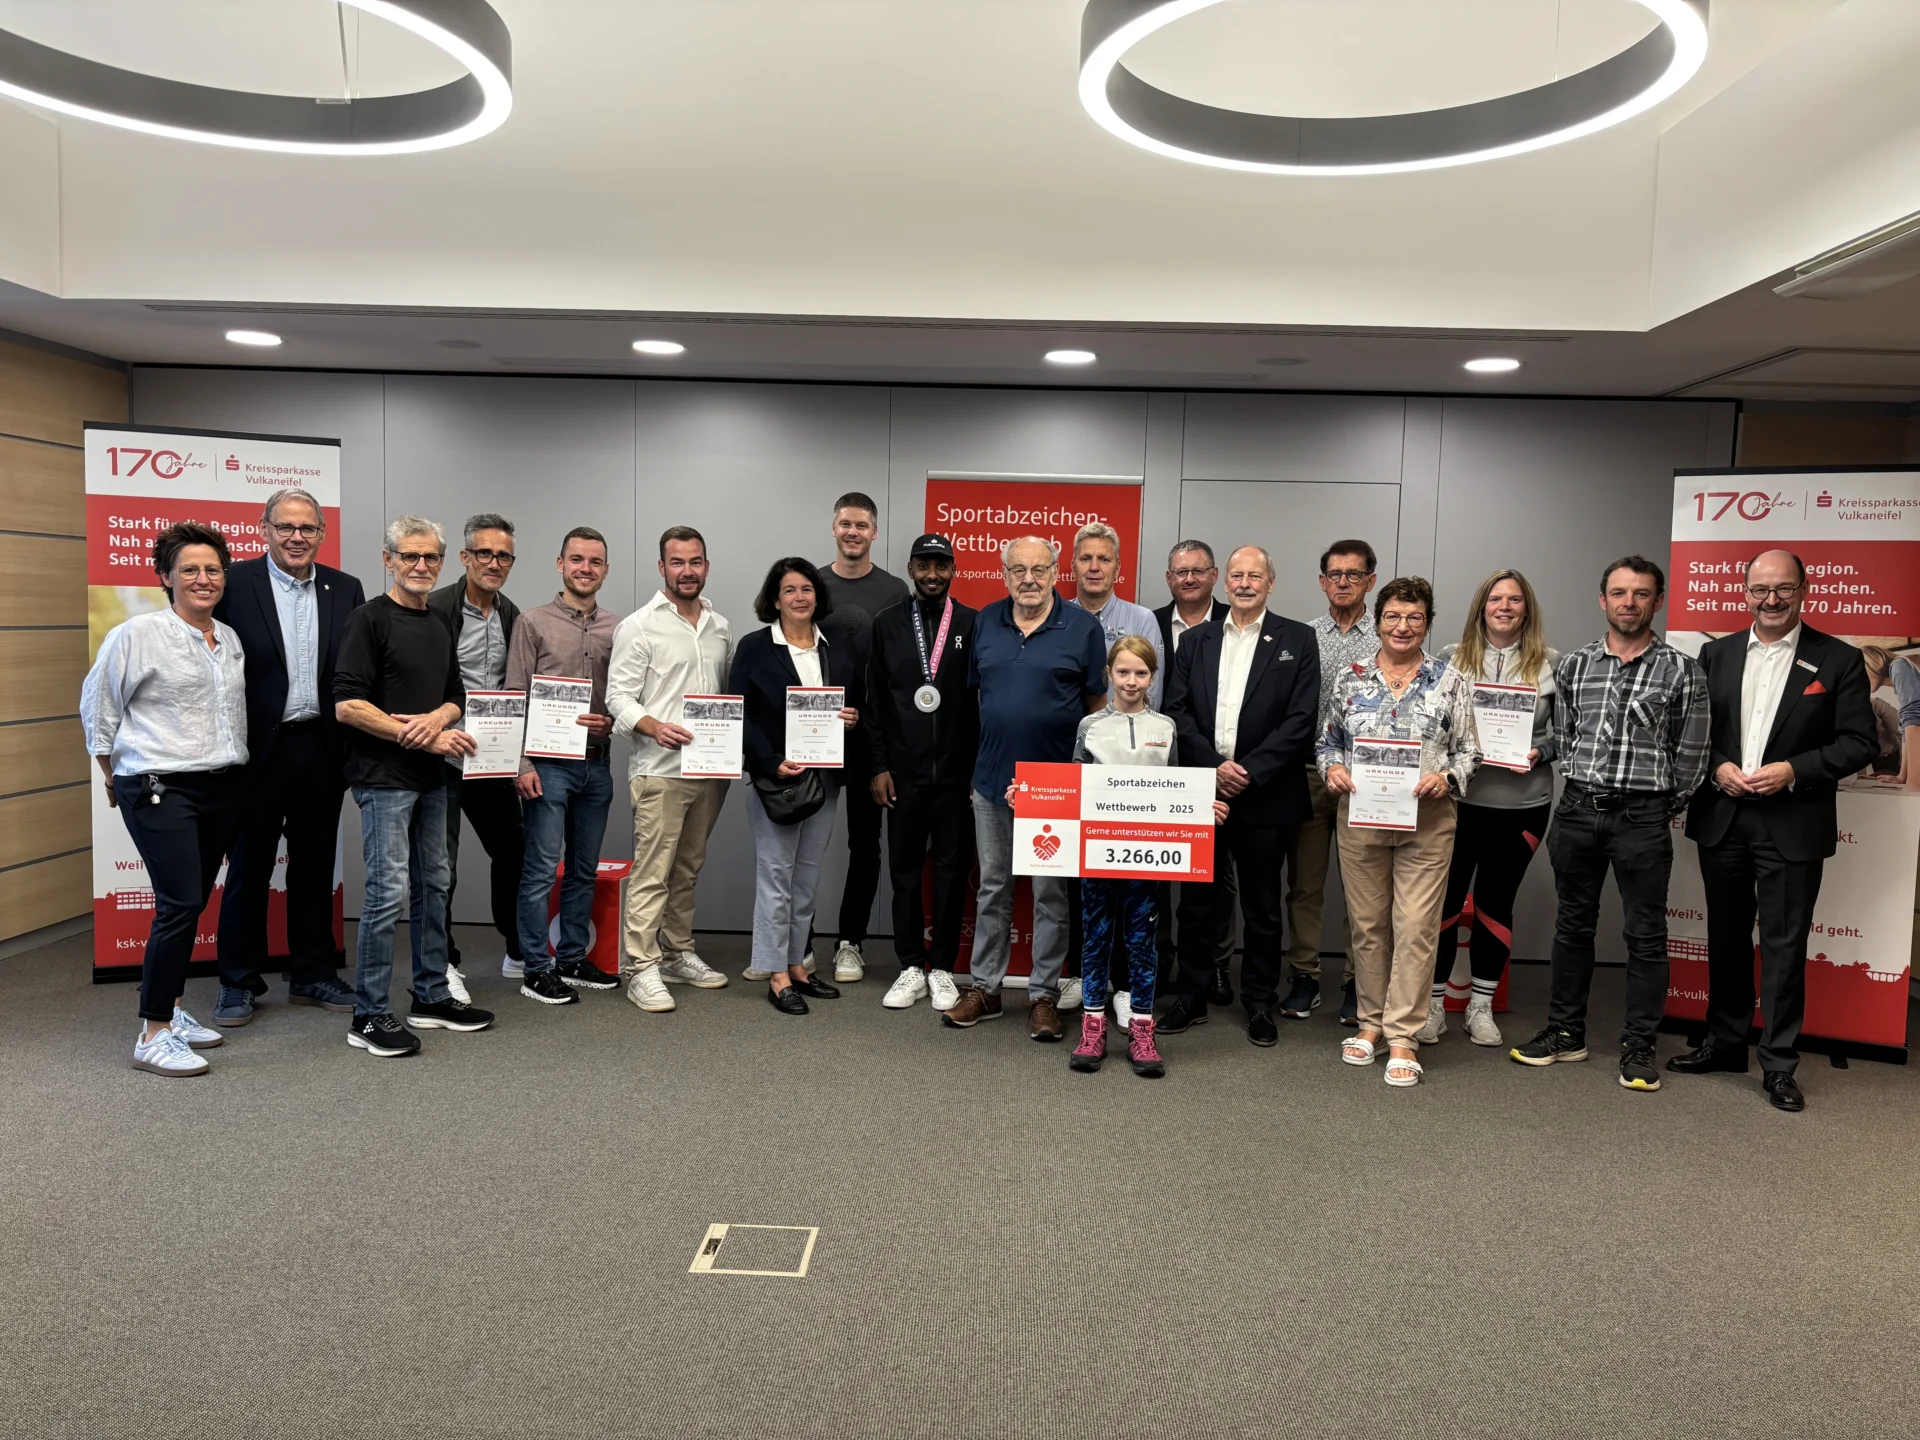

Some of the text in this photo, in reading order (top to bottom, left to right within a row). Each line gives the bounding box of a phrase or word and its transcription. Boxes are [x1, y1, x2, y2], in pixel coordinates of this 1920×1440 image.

[106, 447, 184, 479] 170
[165, 452, 207, 473] Jahre
[245, 462, 321, 477] Kreissparkasse
[245, 474, 302, 487] Vulkaneifel
[1693, 491, 1772, 521] 170
[1751, 491, 1797, 516] Jahre
[936, 503, 1107, 528] Sportabzeichen-
[1837, 510, 1902, 520] Vulkaneifel
[108, 515, 151, 530] Stark
[109, 534, 141, 548] Nah
[109, 552, 141, 567] Seit
[1689, 561, 1859, 577] Stark fü egion.
[1688, 580, 1719, 593] Nah
[1809, 581, 1876, 595] nschen.
[1686, 598, 1717, 612] Seit
[1800, 600, 1829, 613] 170
[1832, 601, 1898, 615] Jahren.
[1482, 711, 1521, 719] URKUNDE
[1365, 768, 1406, 776] URKUNDE
[1031, 786, 1077, 794] Kreissparkasse
[1107, 778, 1186, 789] Sportabzeichen
[1096, 802, 1194, 814] Wettbewerb 2025
[1085, 826, 1209, 839] Gerne unterstützen wir Sie mit
[115, 859, 143, 870] Weil
[1105, 848, 1182, 867] 3.266,00
[1192, 867, 1209, 875] Euro.
[1665, 908, 1704, 920] Weil's
[1827, 926, 1863, 938] geht.
